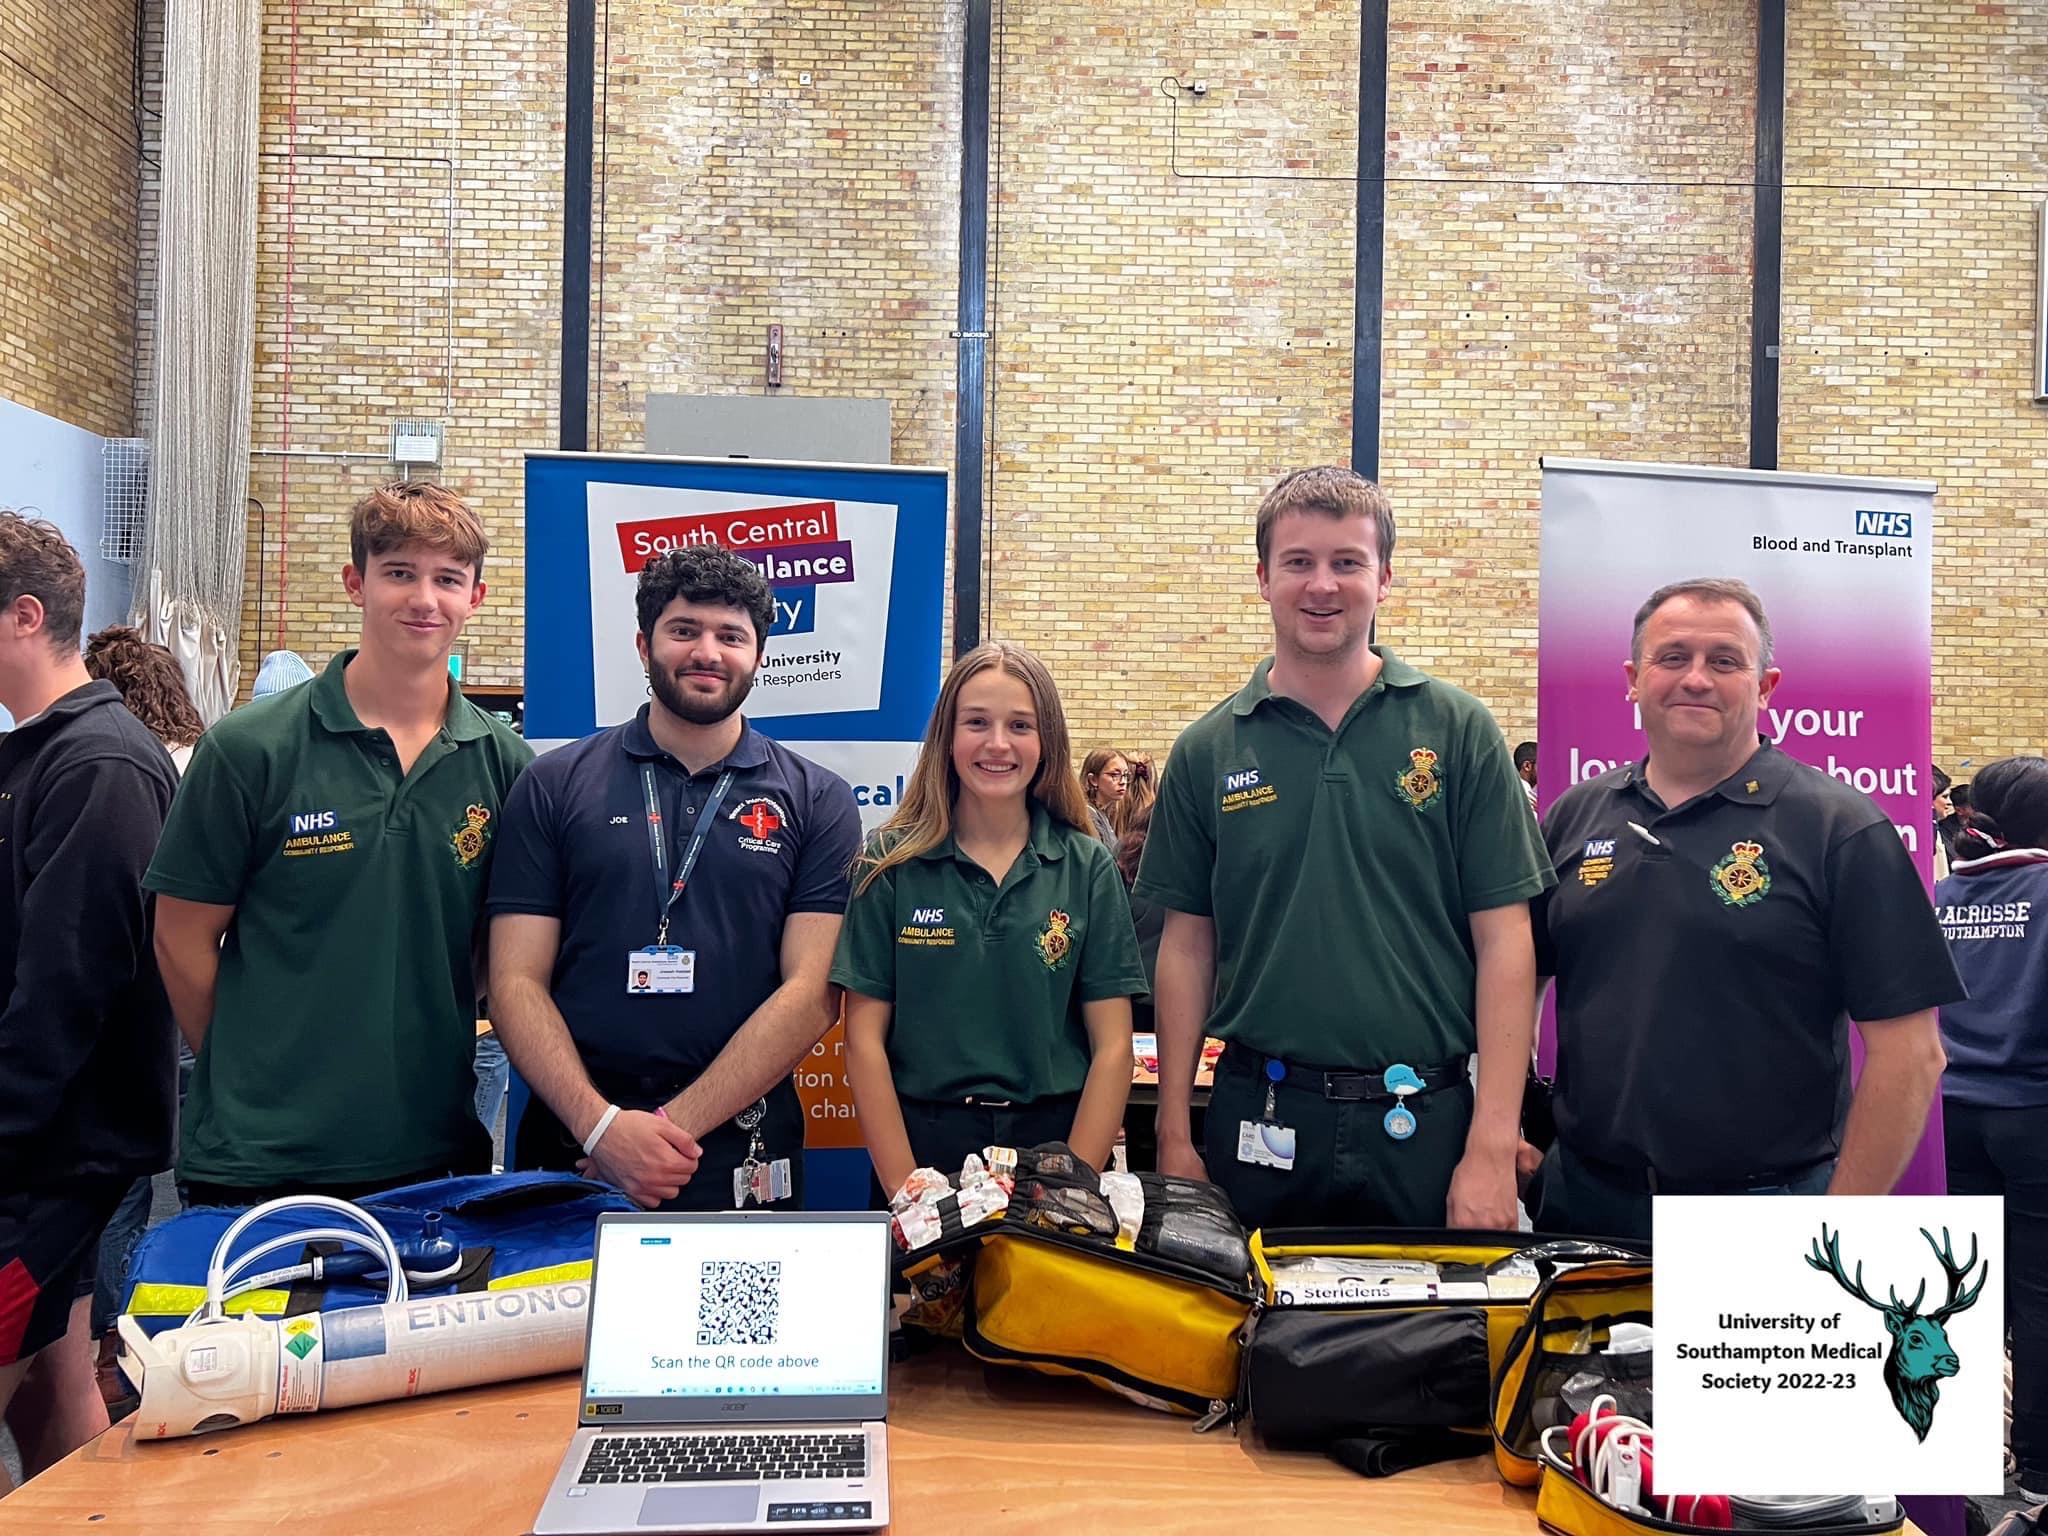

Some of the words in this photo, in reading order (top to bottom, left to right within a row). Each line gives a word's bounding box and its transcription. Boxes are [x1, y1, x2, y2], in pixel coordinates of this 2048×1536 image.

[634, 523, 718, 556] South
[727, 510, 829, 545] Central
[1857, 511, 1910, 536] NHS
[1753, 536, 1798, 551] Blood
[1803, 539, 1830, 553] and
[1835, 540, 1913, 559] Transplant
[760, 649, 841, 668] University
[763, 668, 842, 687] Responders
[1768, 706, 1864, 744] your
[1228, 770, 1259, 790] NHS
[294, 811, 335, 833] NHS
[609, 816, 629, 825] JOE
[285, 831, 352, 849] AMBULANCE
[1585, 840, 1616, 858] NHS
[912, 908, 945, 924] NHS
[901, 926, 956, 938] AMBULANCE
[1303, 1286, 1392, 1299] Stericlens
[406, 1285, 590, 1332] ENTONO
[651, 1355, 684, 1369] Scan
[688, 1355, 711, 1369] the
[715, 1355, 736, 1370] QR
[740, 1355, 773, 1368] code
[777, 1355, 820, 1368] above
[720, 1403, 749, 1412] acer
